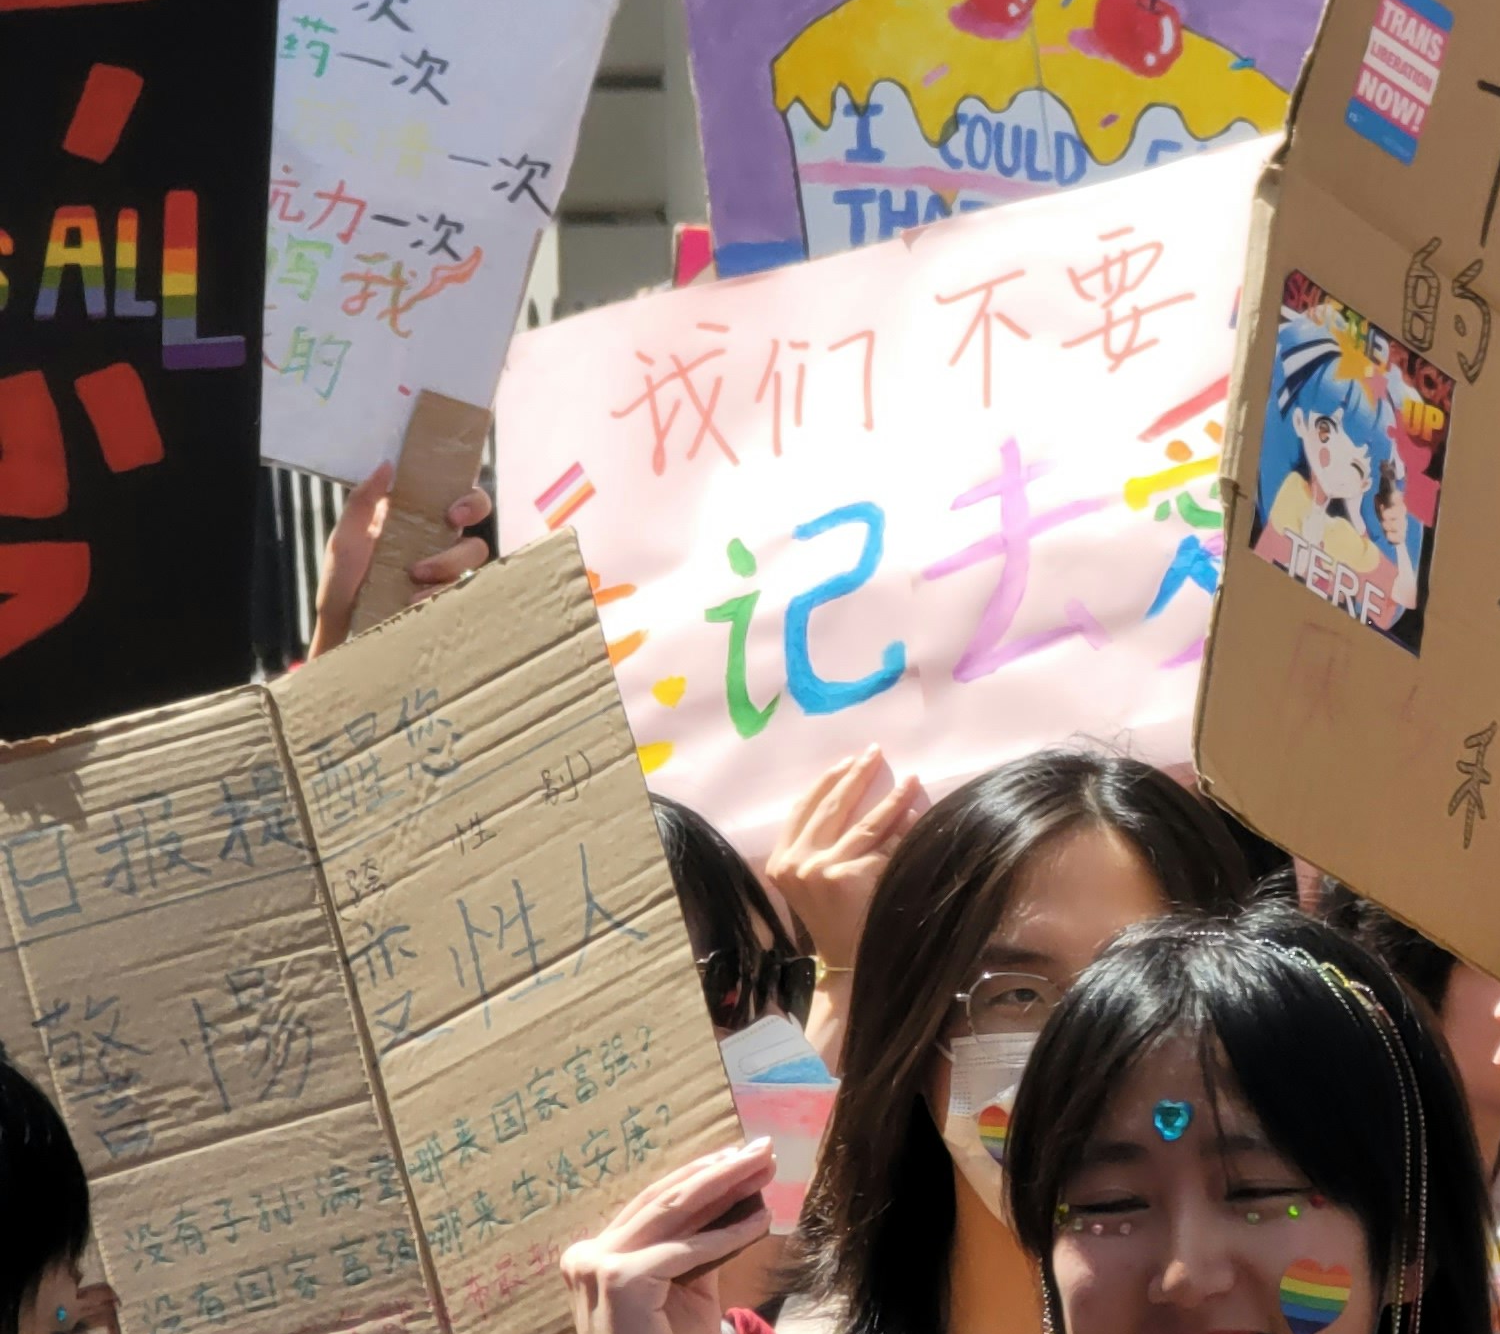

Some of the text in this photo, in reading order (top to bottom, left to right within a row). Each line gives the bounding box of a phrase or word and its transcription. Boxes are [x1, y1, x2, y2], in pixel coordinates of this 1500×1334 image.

[1356, 68, 1426, 134] NOW!
[1369, 40, 1434, 94] LIBERATION
[843, 103, 886, 163] I
[938, 113, 1088, 187] COULD
[33, 189, 248, 369] ALL
[610, 227, 1197, 478] 我们不要
[1401, 397, 1446, 444] UP
[1283, 528, 1387, 626] TERF
